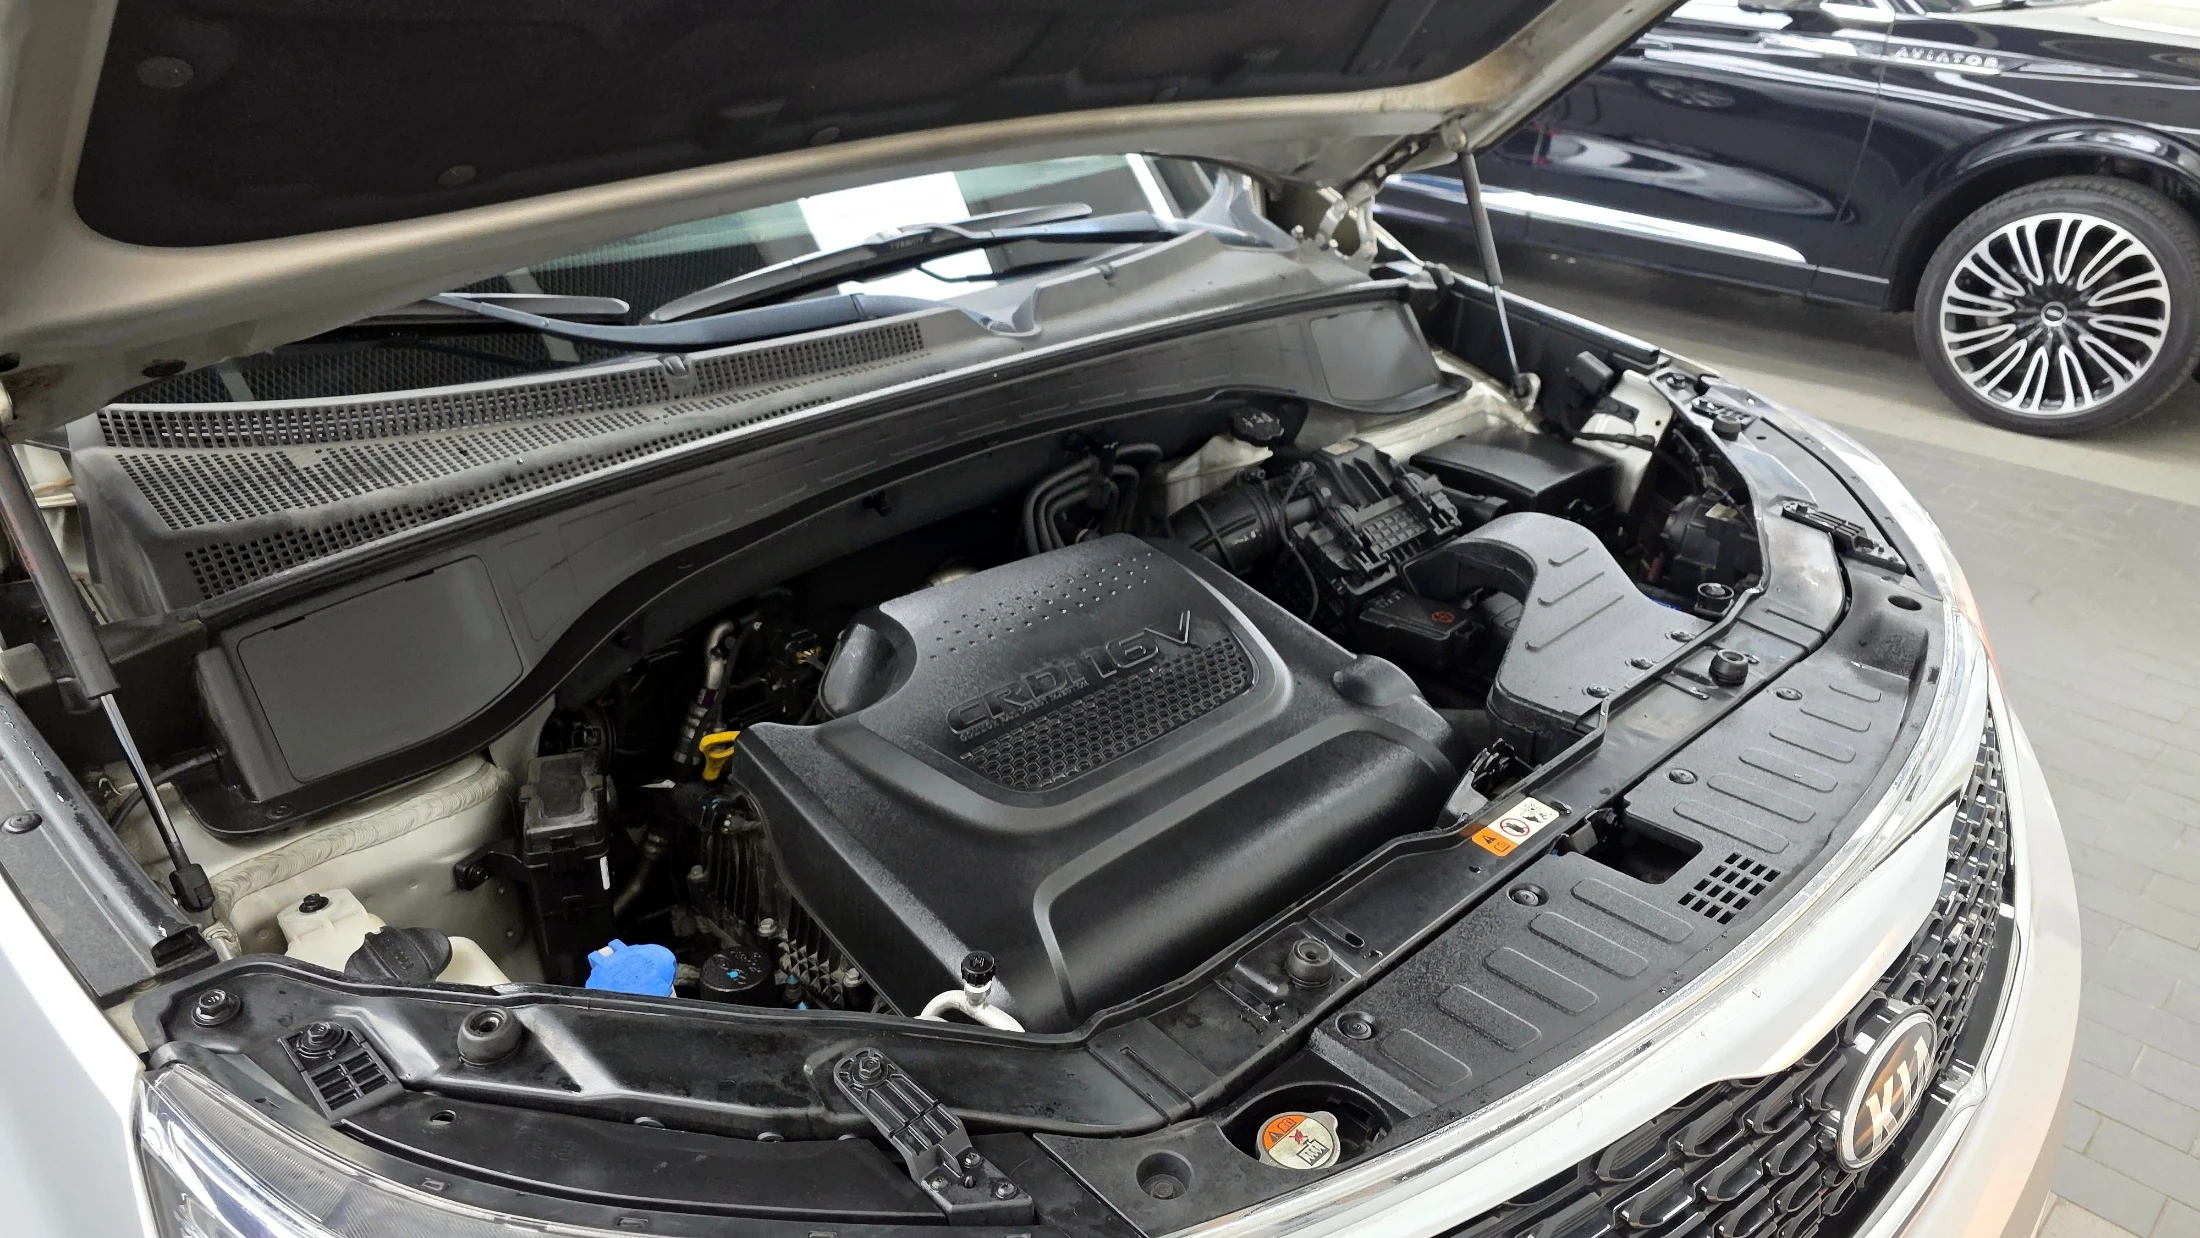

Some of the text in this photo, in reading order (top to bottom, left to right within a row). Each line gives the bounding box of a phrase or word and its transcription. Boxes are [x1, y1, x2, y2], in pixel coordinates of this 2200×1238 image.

[1895, 46, 1999, 68] AVIATOR
[1082, 610, 1190, 679] 16V
[1865, 1034, 1932, 1152] KIA
